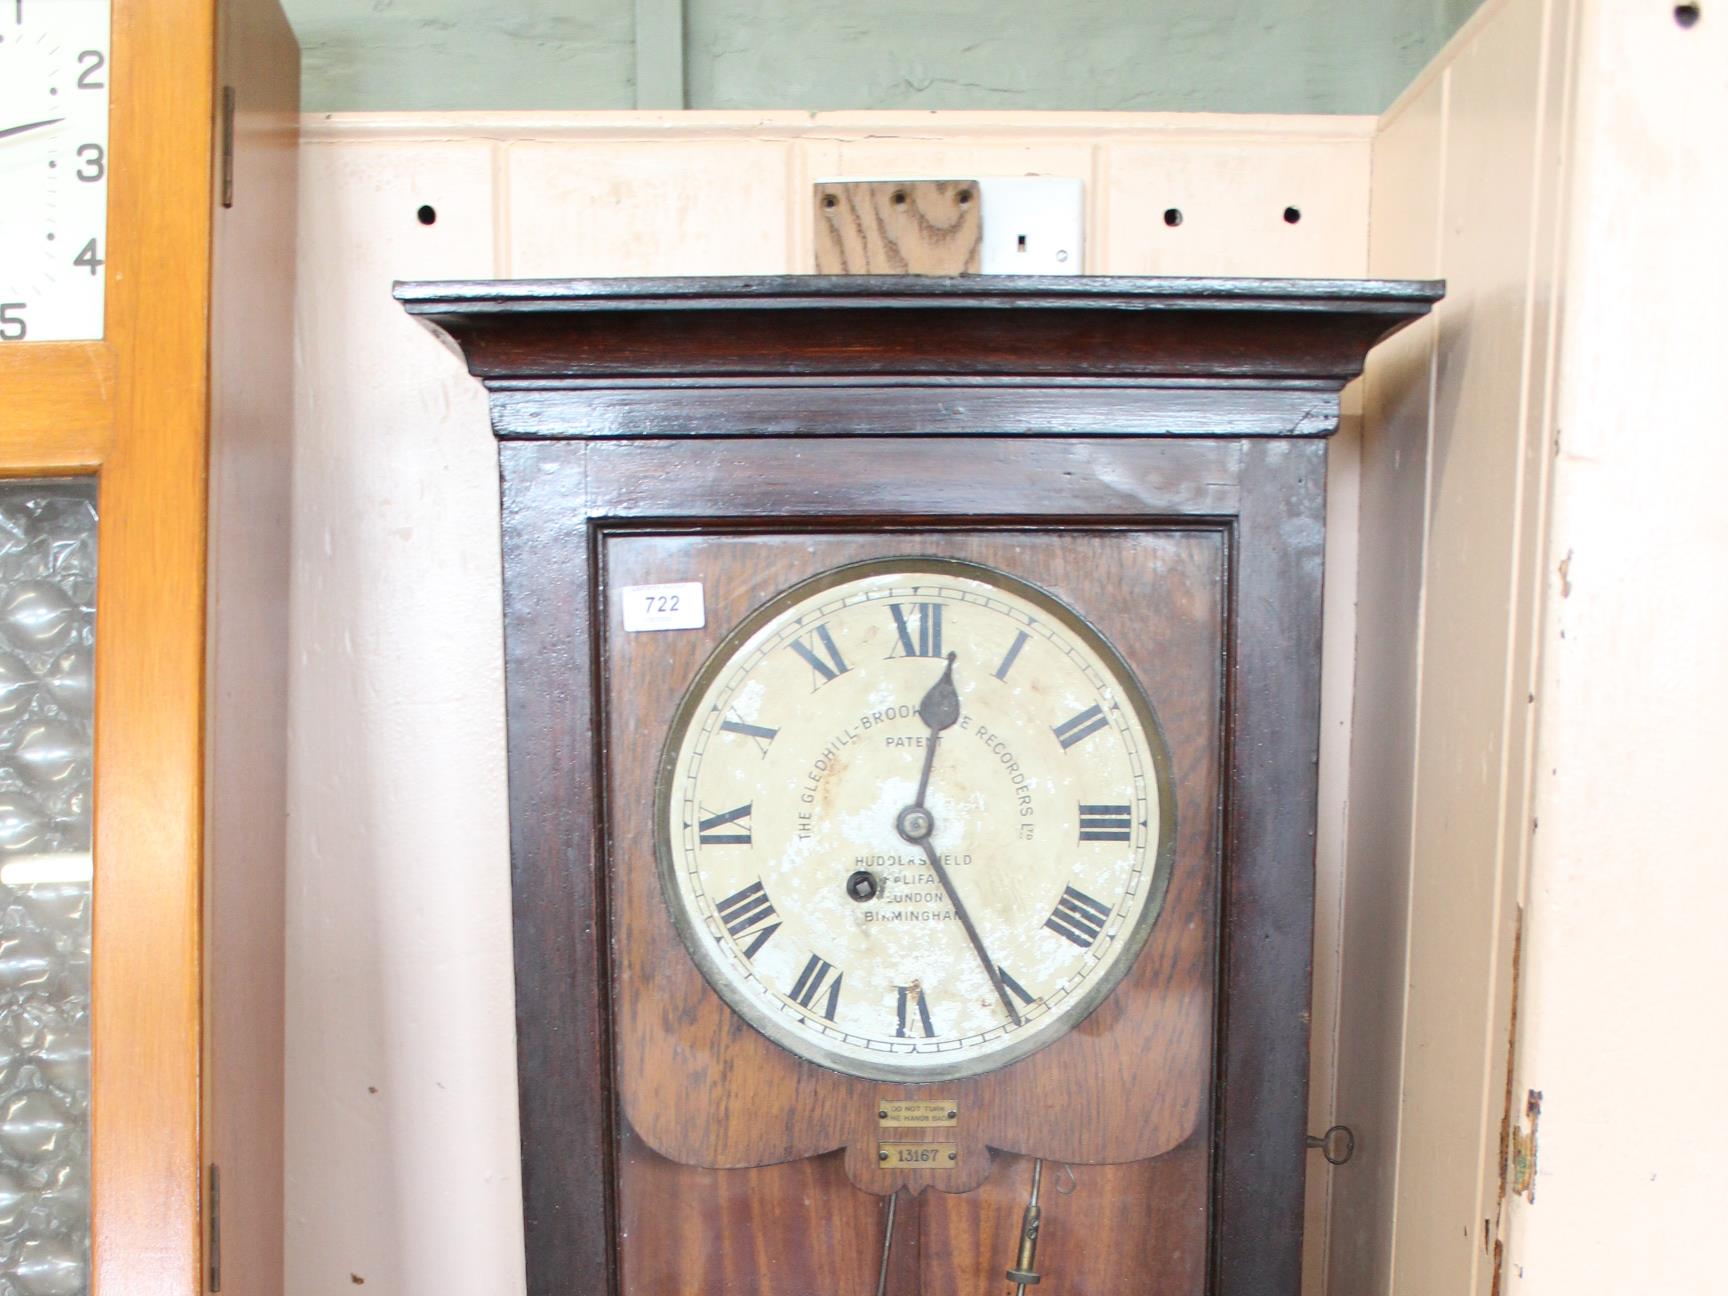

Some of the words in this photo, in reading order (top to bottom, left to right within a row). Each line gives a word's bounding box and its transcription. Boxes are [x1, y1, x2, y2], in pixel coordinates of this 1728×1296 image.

[77, 50, 104, 89] 2
[76, 143, 104, 182] 3
[73, 238, 105, 276] 4
[0, 302, 26, 340] 5
[645, 595, 680, 613] 722
[884, 602, 948, 660] XII
[783, 621, 854, 694] XI
[716, 706, 782, 760] X
[1049, 700, 1112, 755] II
[798, 811, 813, 841] THE
[975, 726, 1034, 817] RECORDERS
[699, 799, 753, 850] IX
[1078, 799, 1132, 849] III
[713, 874, 783, 966] VIII
[1040, 880, 1116, 954] IIII
[783, 950, 844, 1025] VII
[898, 1149, 939, 1162] 13167
